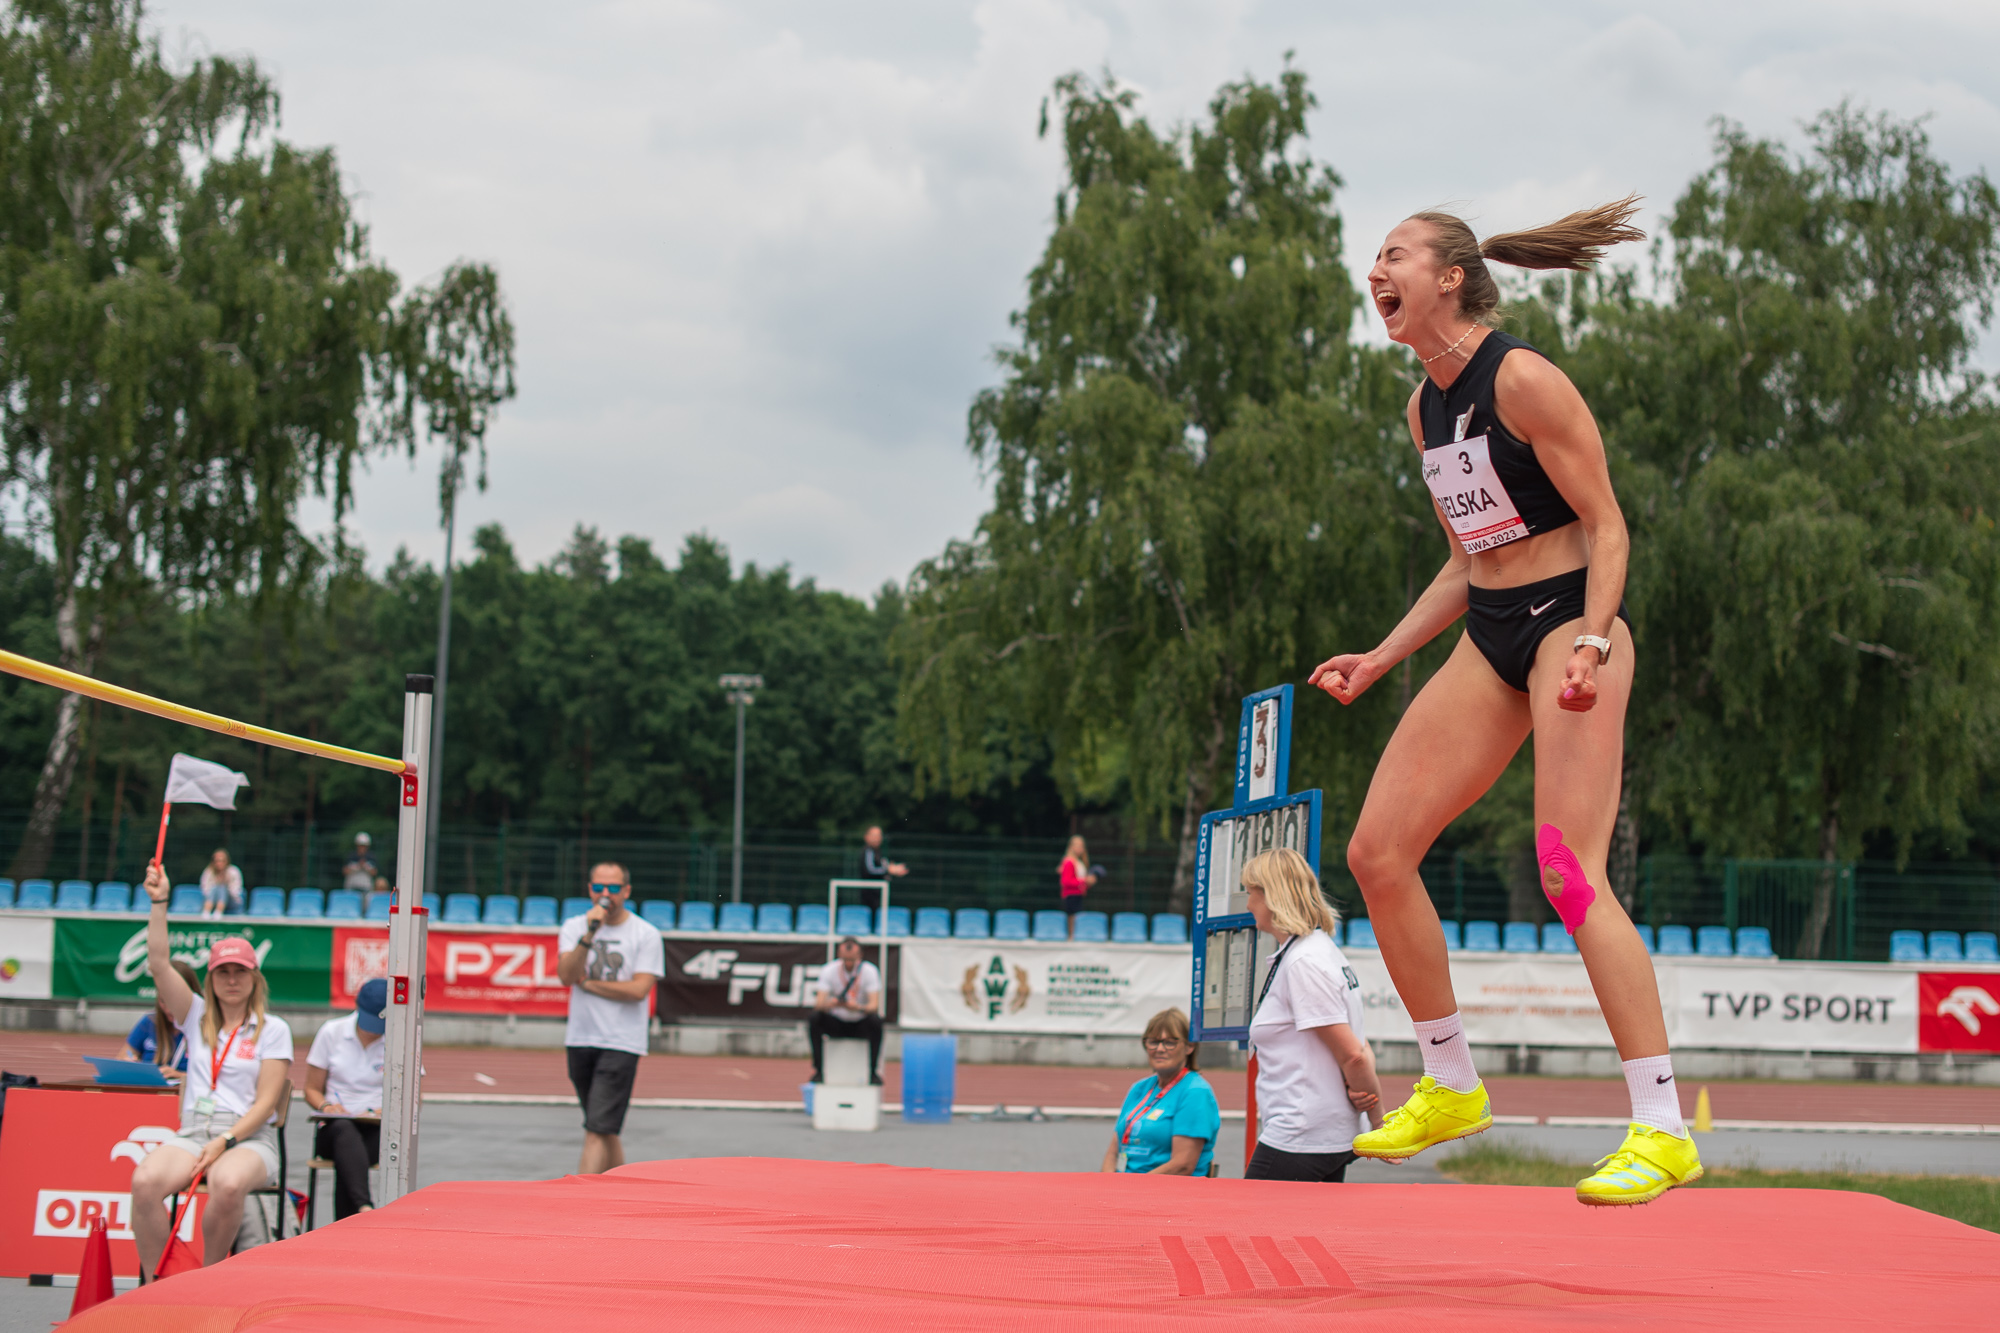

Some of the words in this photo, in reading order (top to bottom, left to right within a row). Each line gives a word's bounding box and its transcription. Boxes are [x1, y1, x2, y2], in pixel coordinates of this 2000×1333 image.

[1458, 451, 1473, 475] 3
[1491, 529, 1517, 545] 2023
[1254, 708, 1269, 778] 3
[1196, 823, 1208, 924] DOSSARD
[682, 950, 738, 979] 4F
[1702, 992, 1771, 1019] TVP
[1782, 994, 1896, 1023] SPORT
[46, 1198, 182, 1233] ORL
